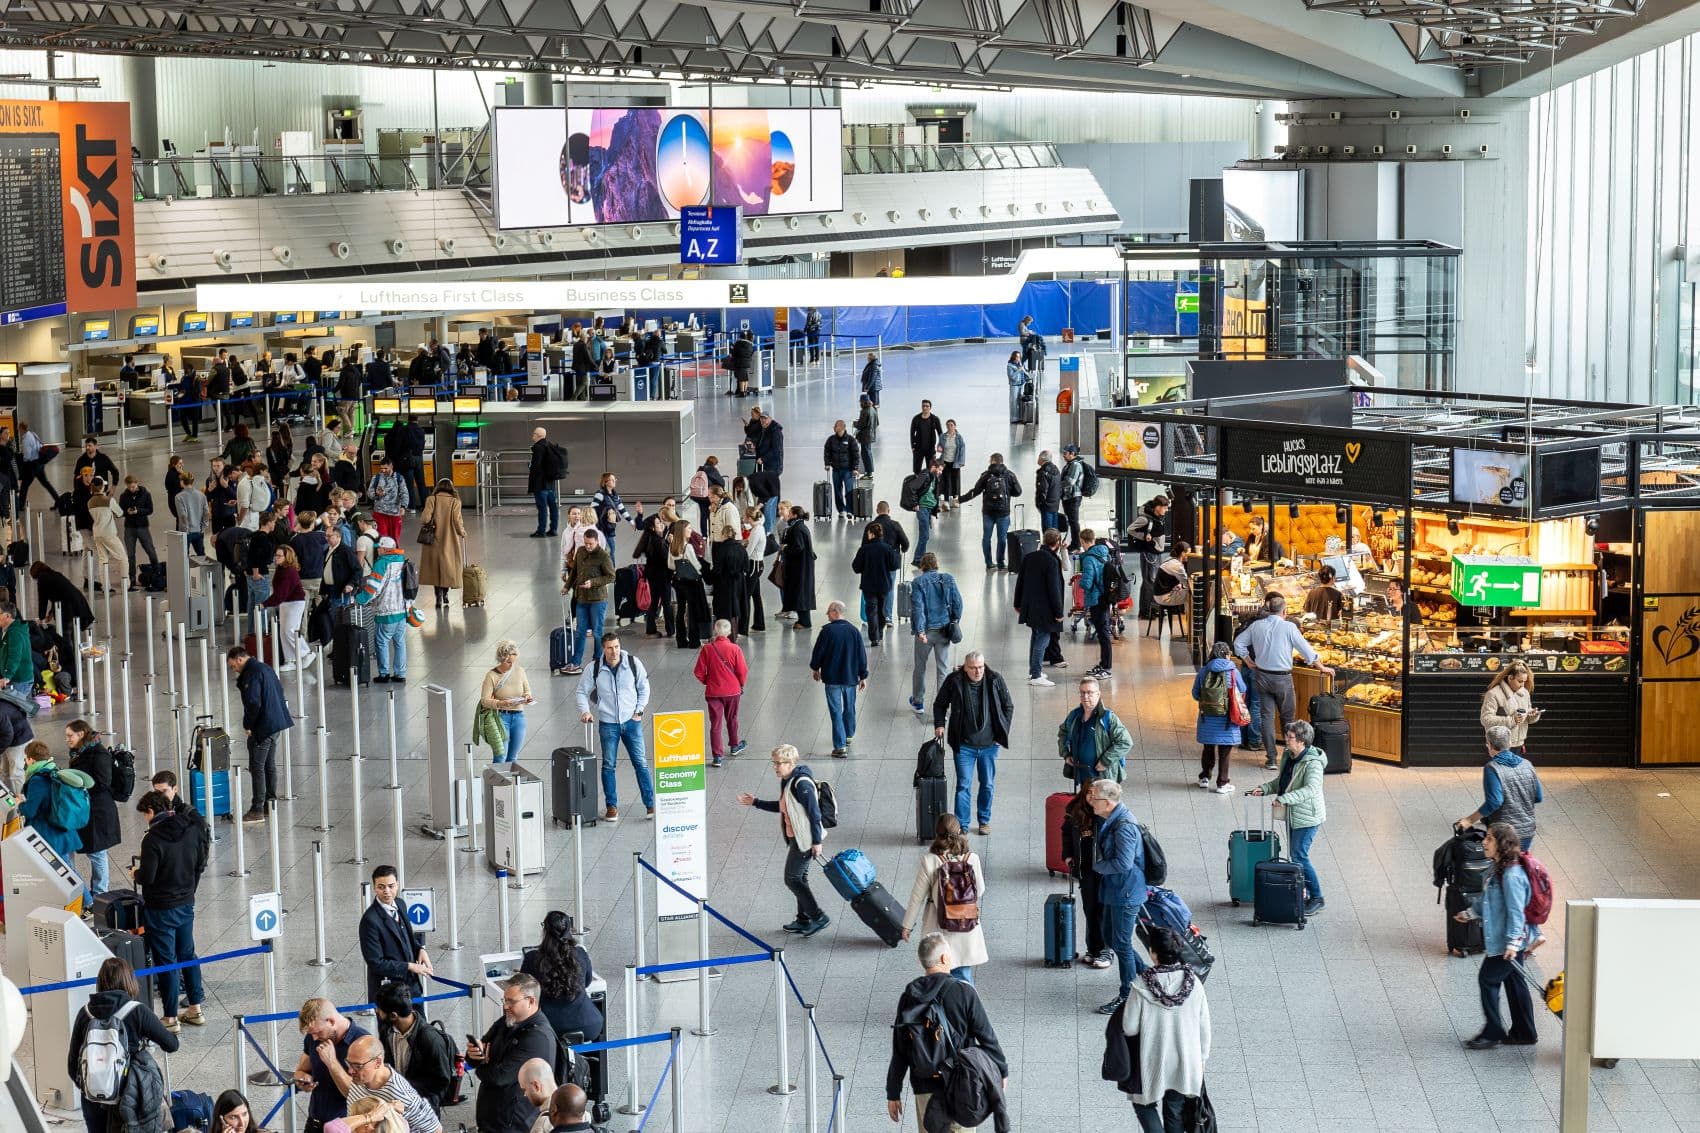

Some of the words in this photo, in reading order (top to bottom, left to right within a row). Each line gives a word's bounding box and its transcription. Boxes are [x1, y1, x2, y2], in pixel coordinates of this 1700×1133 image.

[13, 105, 21, 127] IS
[23, 105, 44, 127] SIXT.
[360, 289, 438, 304] Lufthansa
[443, 289, 480, 303] First
[482, 288, 525, 303] Class
[566, 287, 636, 302] Business
[640, 286, 685, 301] Class
[658, 753, 701, 763] Lufthansa
[659, 770, 698, 780] Economy
[659, 780, 683, 788] Class
[662, 824, 699, 833] discover
